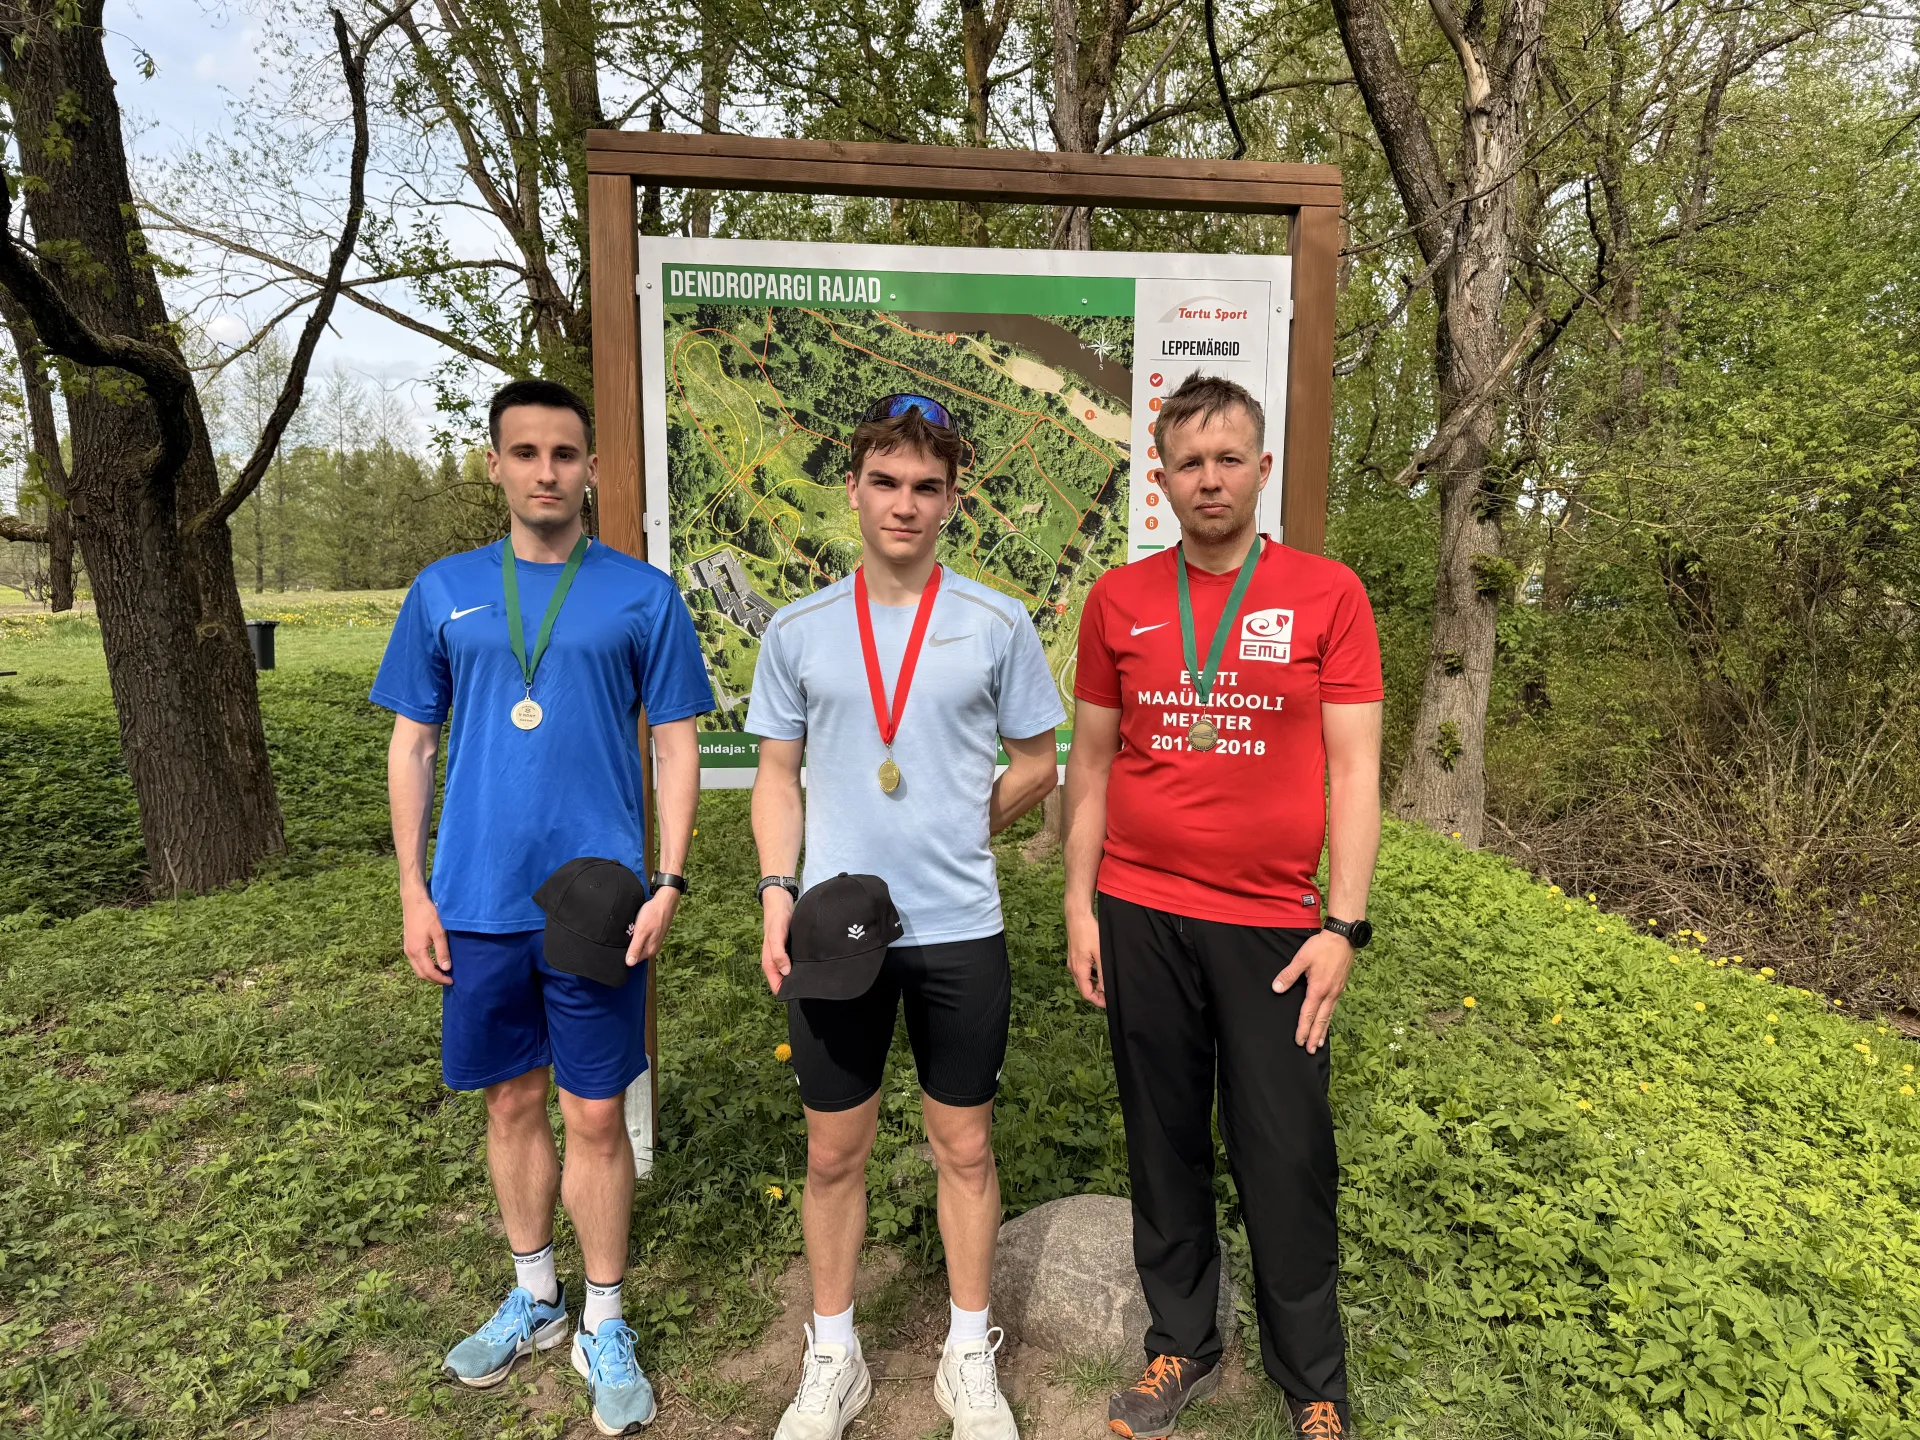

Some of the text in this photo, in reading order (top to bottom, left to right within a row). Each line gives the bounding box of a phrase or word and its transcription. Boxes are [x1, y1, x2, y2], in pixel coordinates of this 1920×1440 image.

[670, 270, 881, 303] DENDROPARGI RAJAD
[1178, 307, 1248, 321] Tartu Sport
[1162, 338, 1240, 356] LEPPEMÄRGID
[1098, 363, 1104, 371] S
[1180, 670, 1239, 686] ETI
[1137, 688, 1285, 711] MAAÜLIKOOLI
[1215, 739, 1266, 755] 2018
